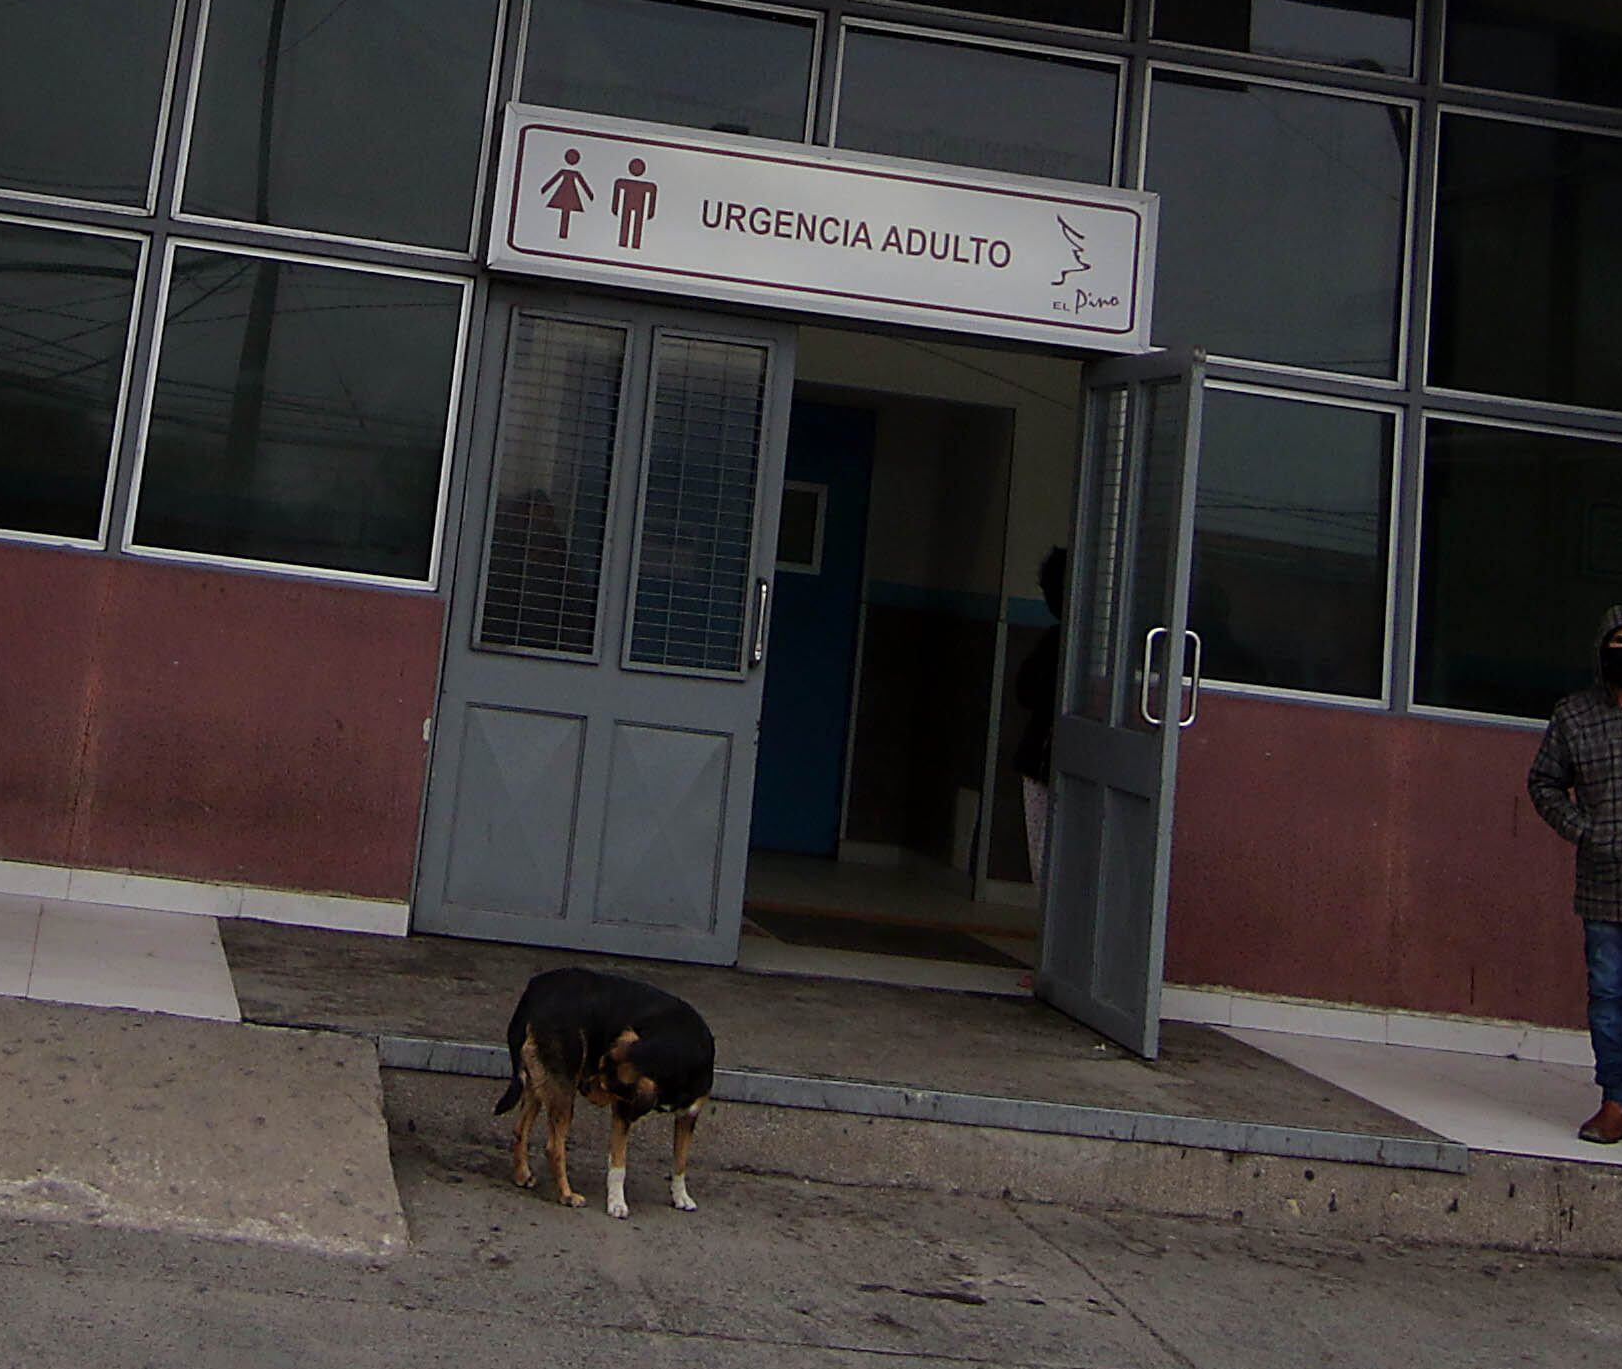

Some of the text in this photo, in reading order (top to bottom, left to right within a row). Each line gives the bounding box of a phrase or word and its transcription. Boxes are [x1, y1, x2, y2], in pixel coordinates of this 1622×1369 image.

[700, 198, 1012, 269] URGENCIA ADULTO
[1052, 287, 1120, 315] EL Pino
